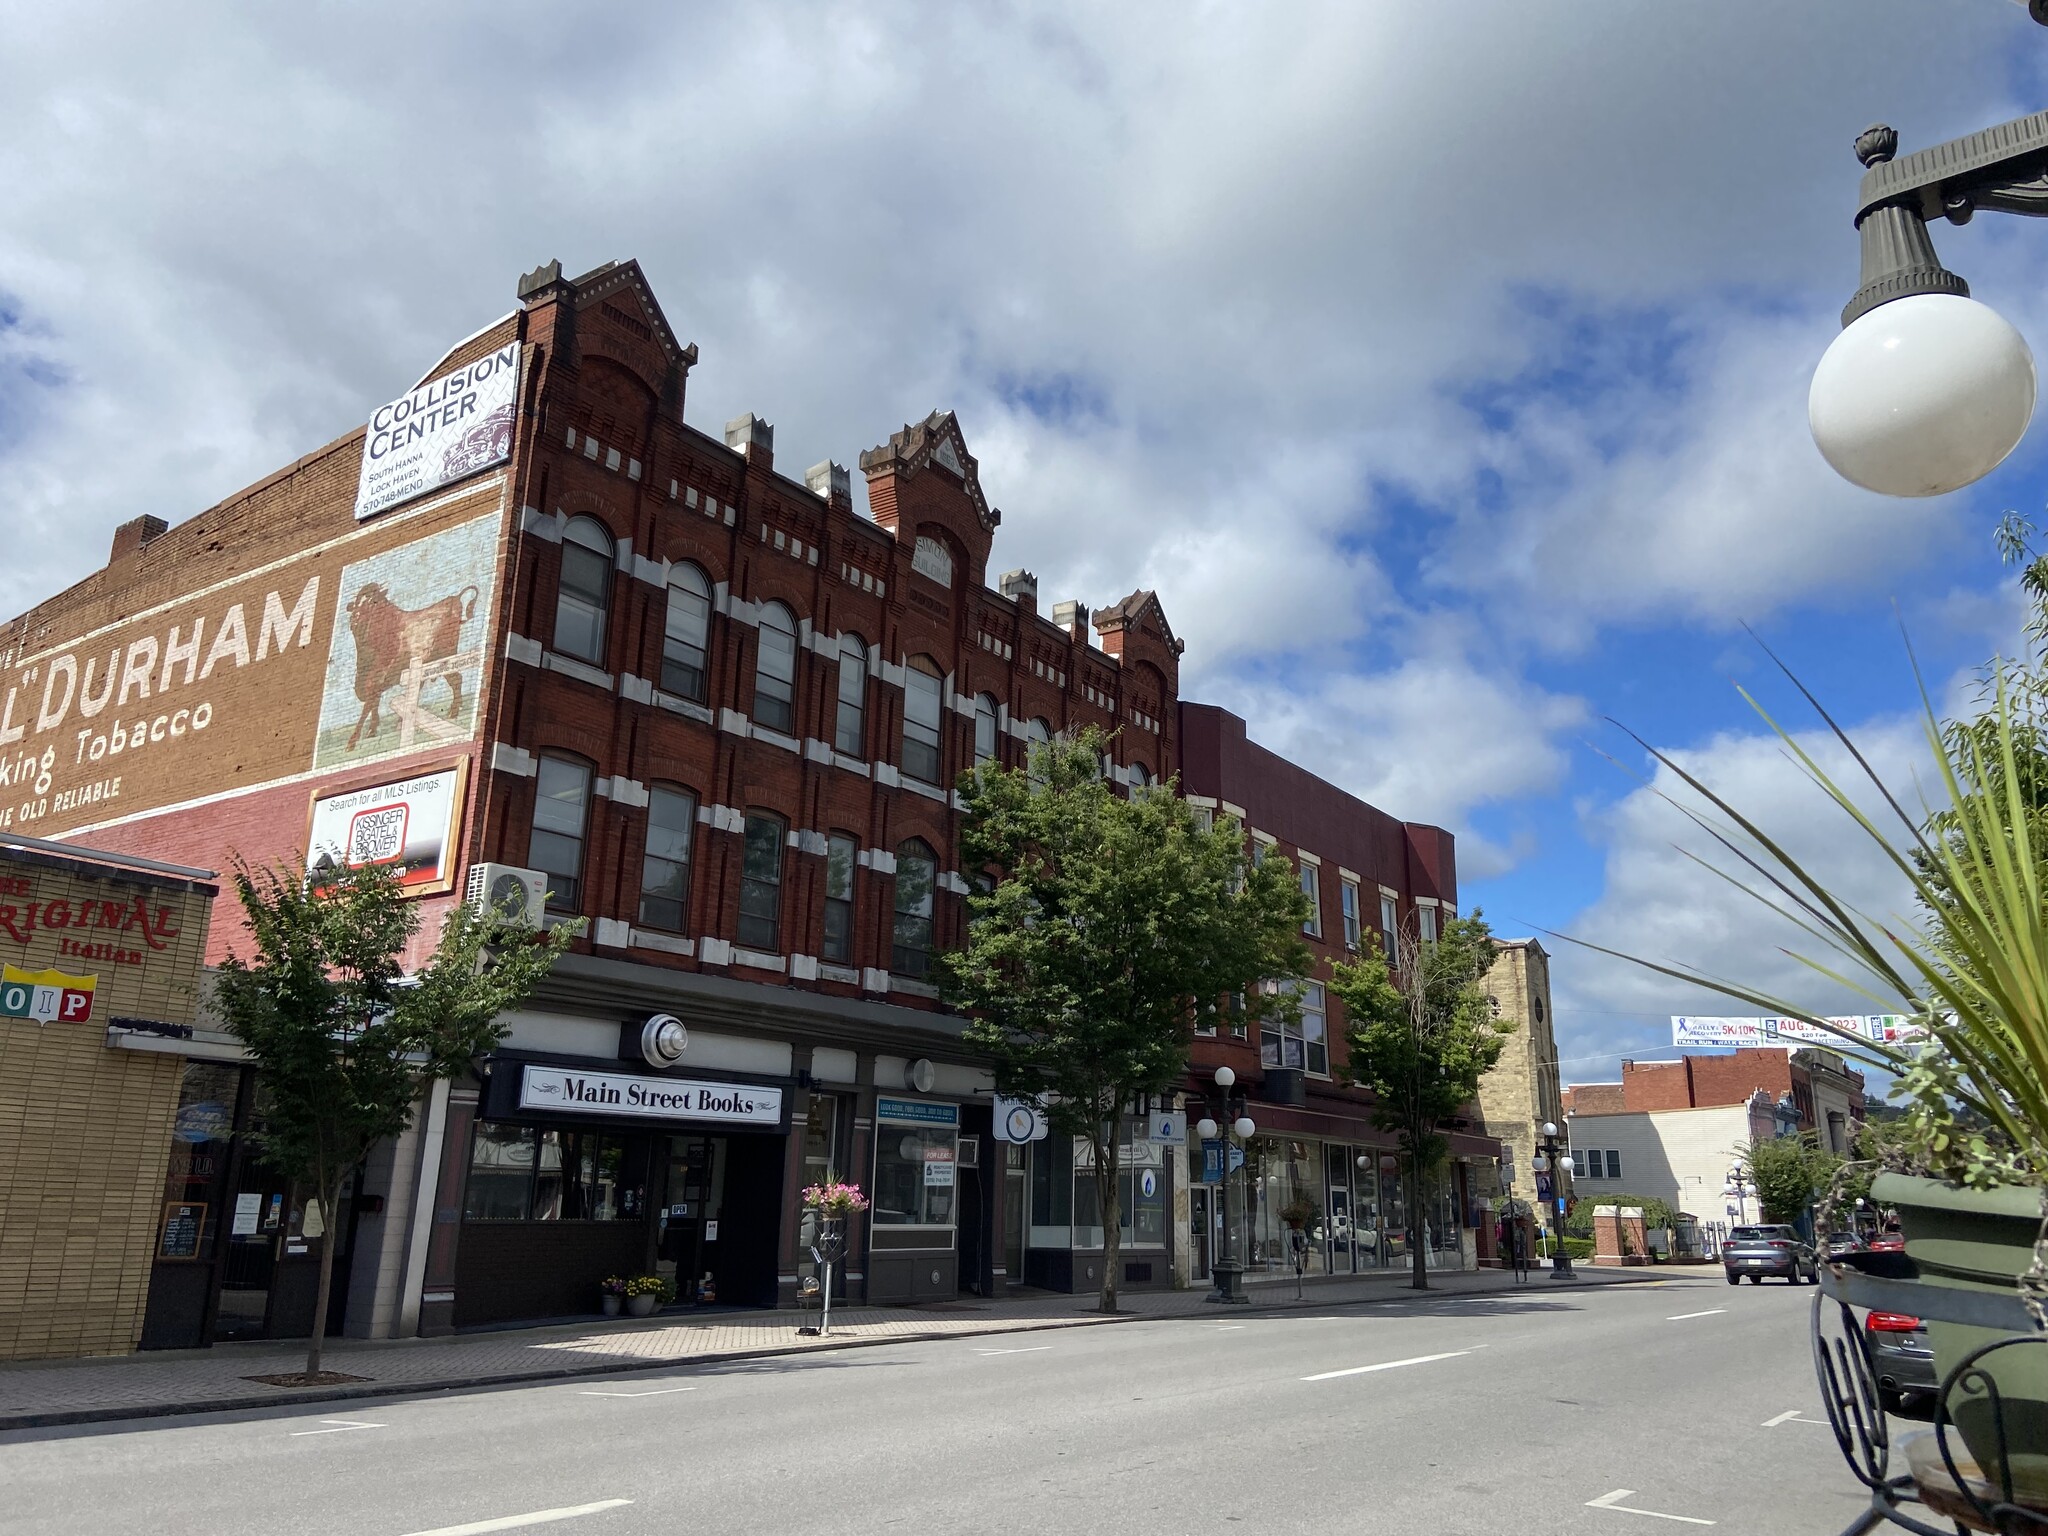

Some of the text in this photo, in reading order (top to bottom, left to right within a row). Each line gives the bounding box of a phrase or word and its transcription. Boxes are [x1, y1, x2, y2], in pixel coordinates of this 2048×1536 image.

[373, 345, 515, 432] COLLISION
[370, 391, 477, 460] CENTER
[368, 452, 423, 484] SOUTH HANNA
[370, 467, 420, 496] LOCK HAVEN
[363, 478, 423, 513] 570-748-MEND
[916, 538, 949, 566] SIMON
[76, 703, 213, 764] Tobacco
[19, 799, 47, 822] OLD
[53, 776, 122, 813] RELIABLE
[329, 778, 441, 812] Search for all MLS Listings.
[356, 808, 403, 830] KISSINGER
[356, 825, 398, 842] BIGATEL &
[356, 836, 397, 855] BROWER
[60, 938, 142, 965] Italian
[1722, 1025, 1756, 1035] 5K/10K
[1780, 1020, 1808, 1031] AUG.
[1871, 1017, 1883, 1040] WHERE
[562, 1078, 754, 1114] Main Street Books
[937, 1152, 953, 1160] LEASE
[673, 1204, 687, 1214] OPEN
